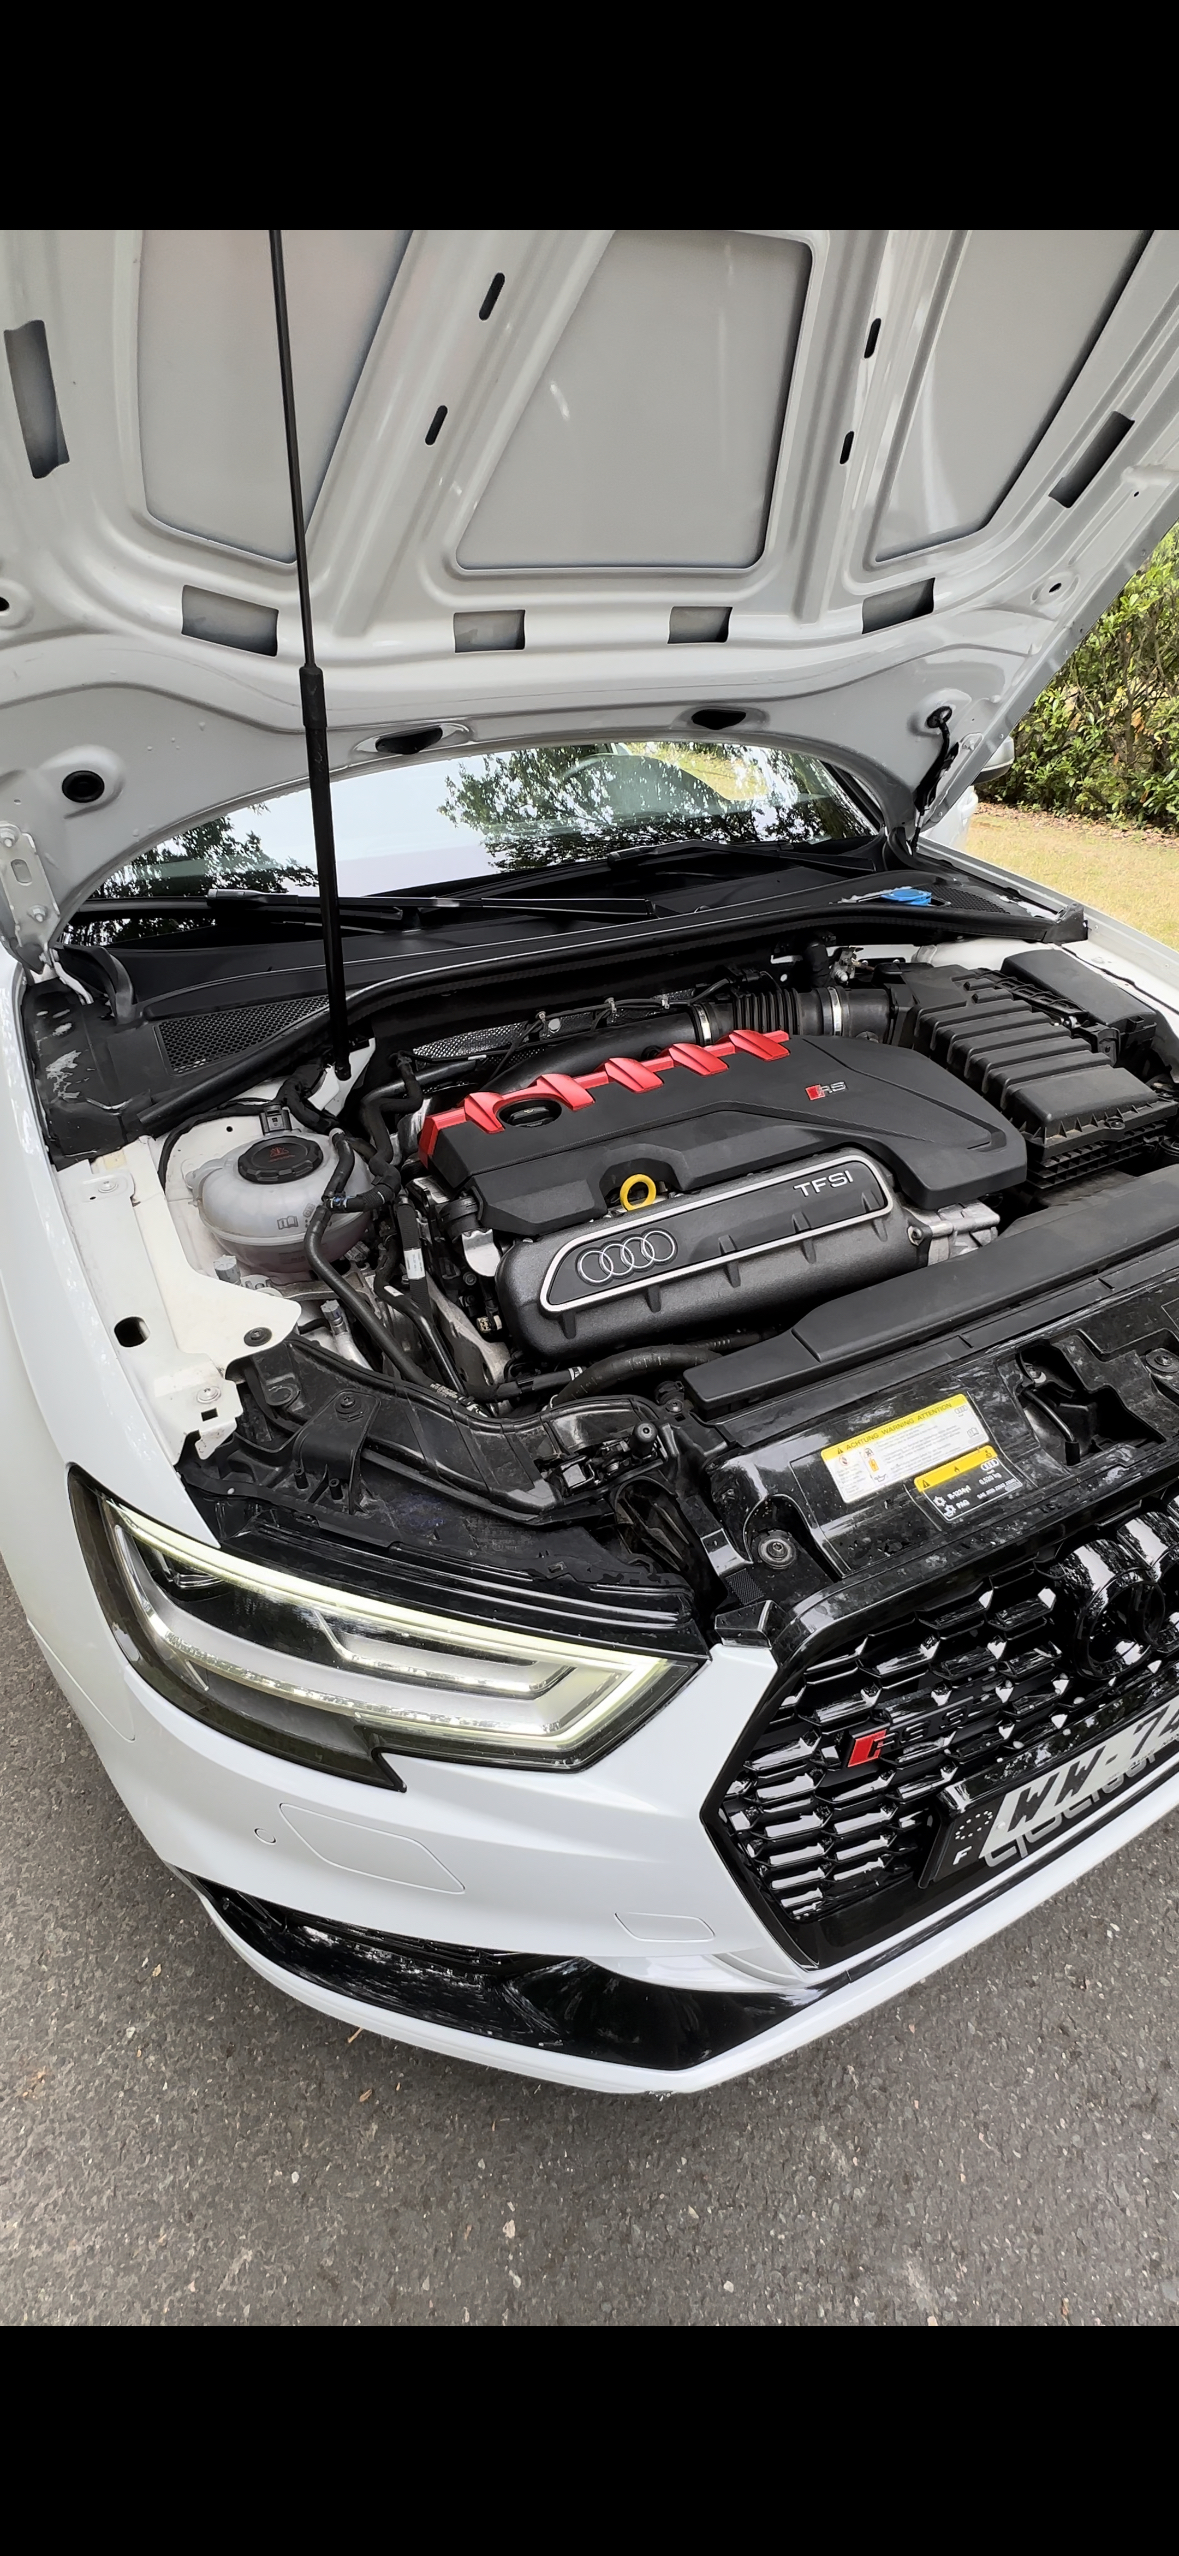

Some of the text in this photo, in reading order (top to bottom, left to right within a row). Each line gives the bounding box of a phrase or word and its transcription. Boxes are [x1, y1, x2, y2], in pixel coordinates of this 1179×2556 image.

[816, 1081, 847, 1098] RS
[793, 1169, 854, 1197] TFSI
[845, 1432, 879, 1450] ACHTUNG
[881, 1417, 914, 1435] WARNING
[917, 1402, 952, 1421] ATTENTION
[952, 1846, 972, 1866] F
